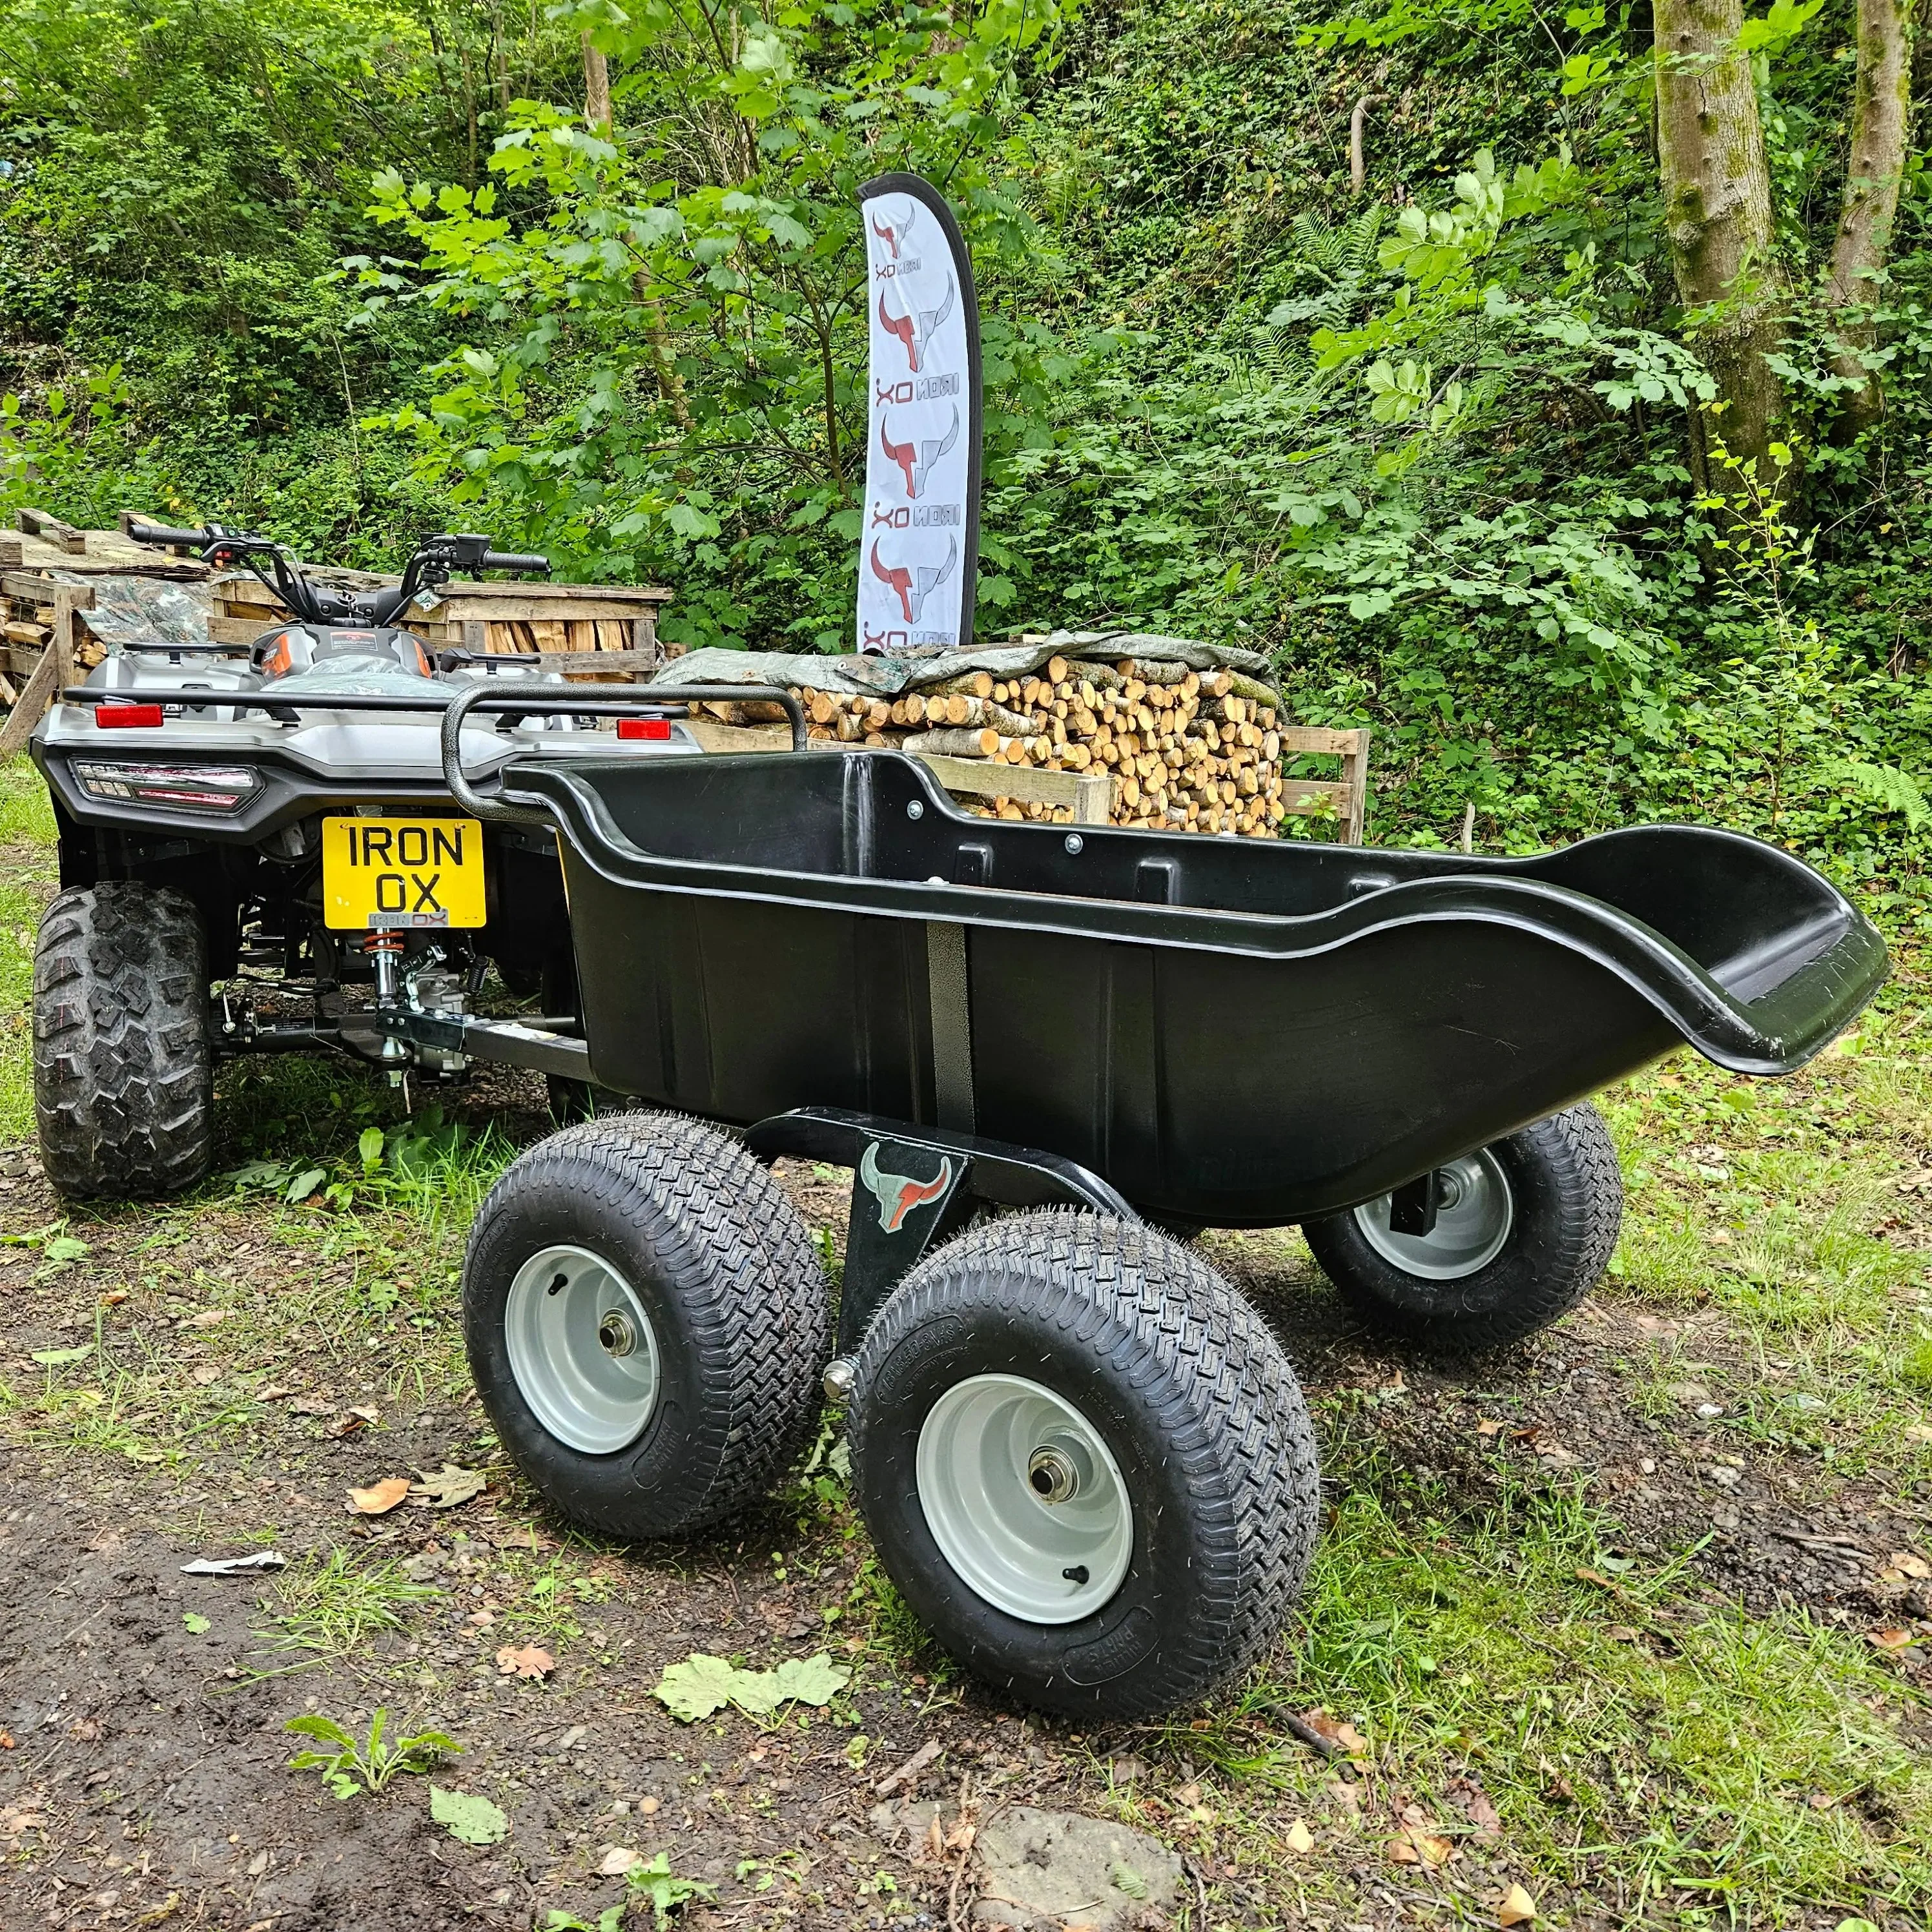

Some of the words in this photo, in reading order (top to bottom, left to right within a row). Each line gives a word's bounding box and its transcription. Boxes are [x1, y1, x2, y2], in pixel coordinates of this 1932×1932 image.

[349, 827, 463, 866] IRON
[376, 873, 442, 913] OX
[369, 914, 409, 927] IRON
[412, 910, 447, 926] OX
